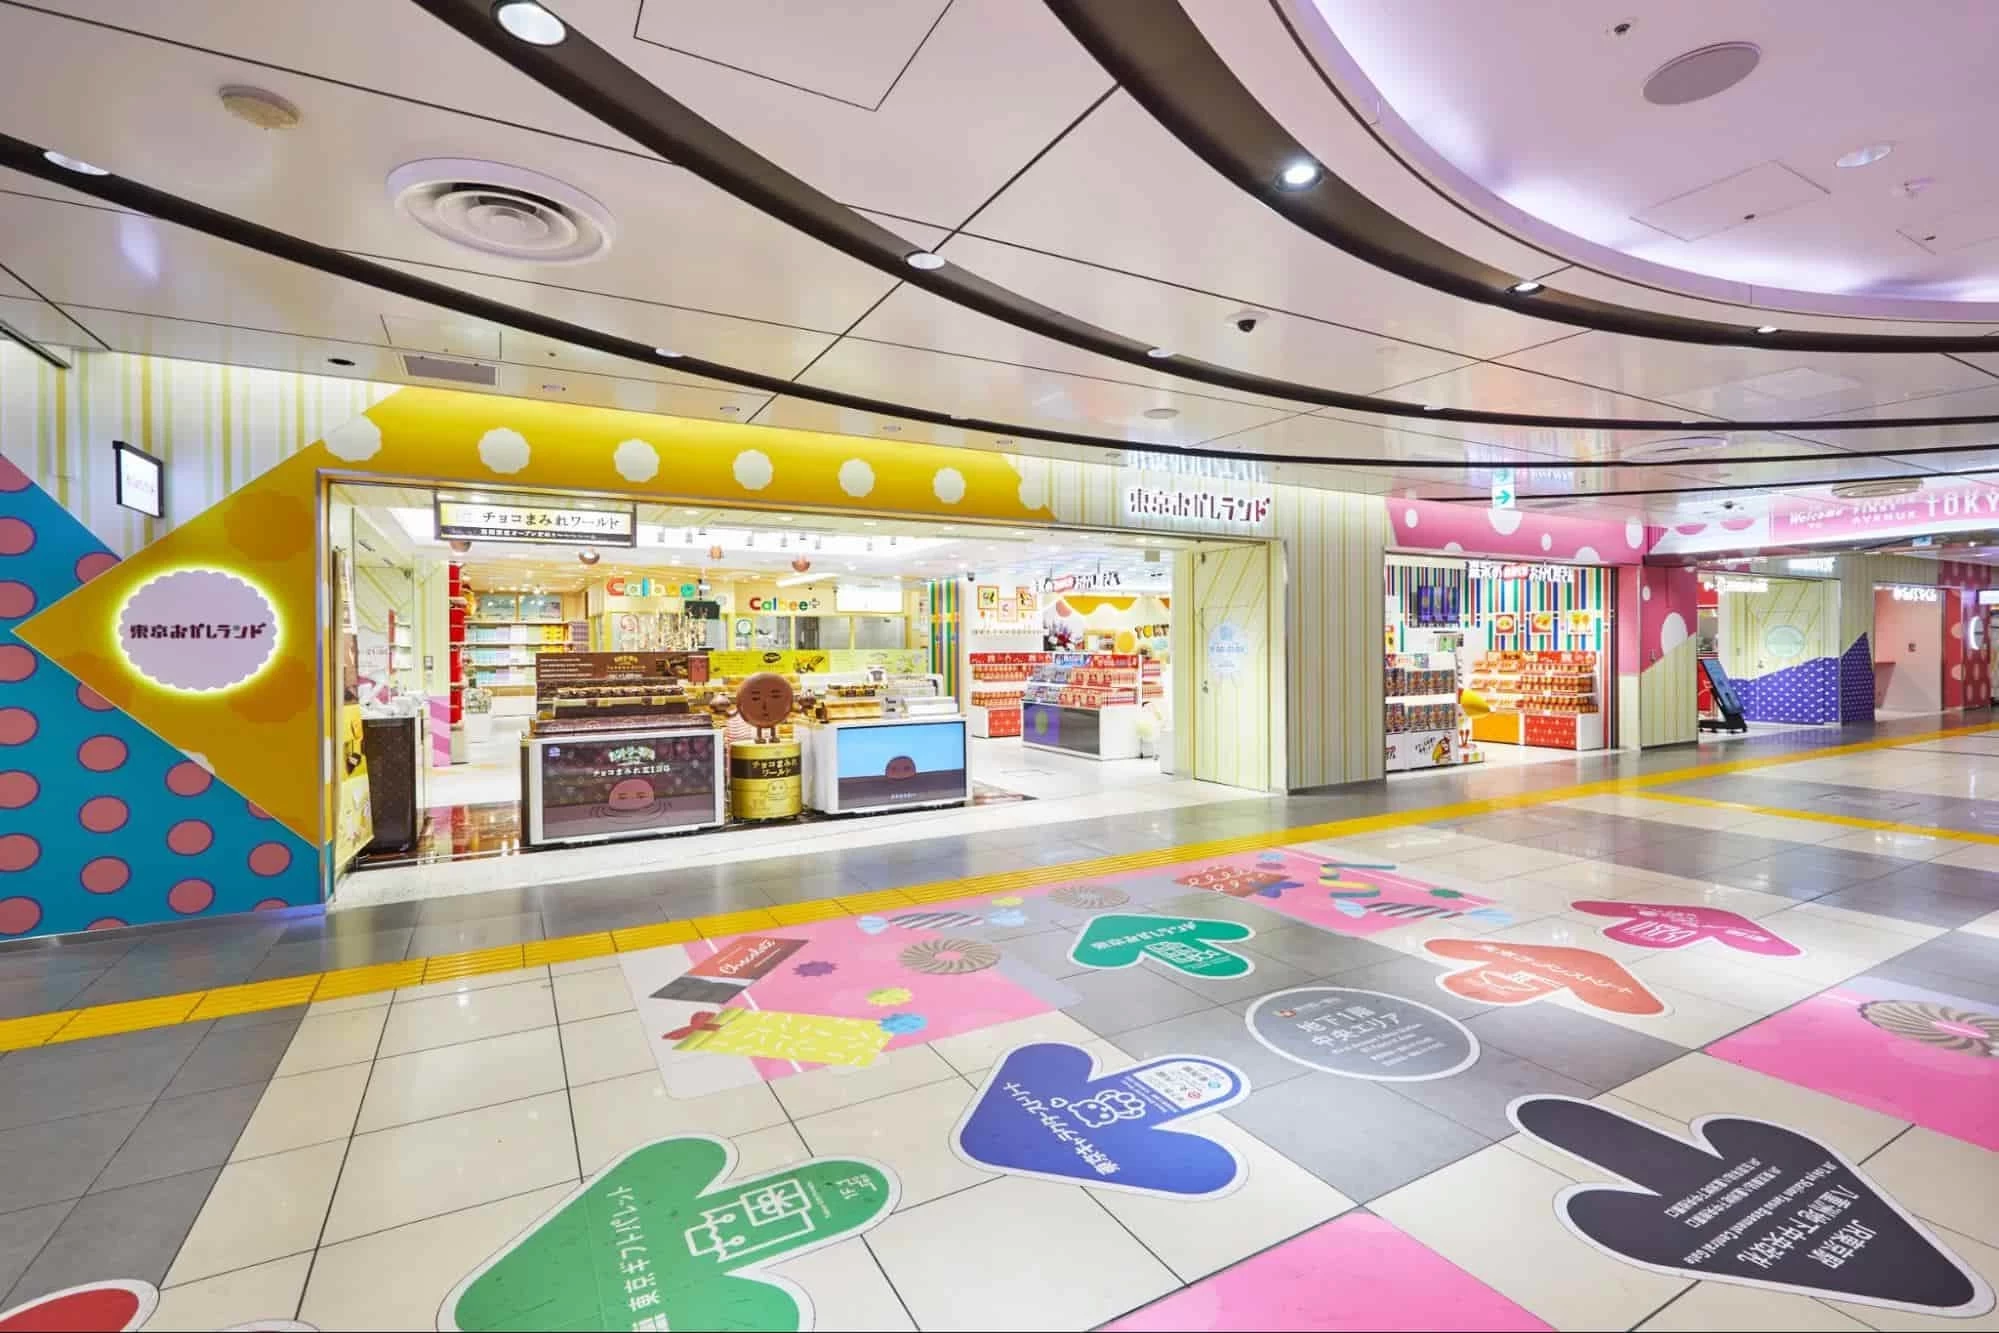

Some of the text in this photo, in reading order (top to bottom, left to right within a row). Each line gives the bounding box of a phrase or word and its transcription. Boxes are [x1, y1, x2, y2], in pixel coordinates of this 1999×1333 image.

[482, 512, 620, 530] チョコまみれワールド
[1789, 507, 1844, 525] Welcome
[606, 577, 696, 598] Calbee
[1312, 1012, 1400, 1047] 中央エリア
[1730, 1206, 1772, 1234] Basement
[1737, 1185, 1859, 1268] 八重洲地下中央改札
[606, 1186, 661, 1310] 東京ギフトパレット
[1702, 1231, 1738, 1254] Central
[1808, 1220, 1876, 1268] JR東京駅
[1684, 1247, 1710, 1264] Gate
